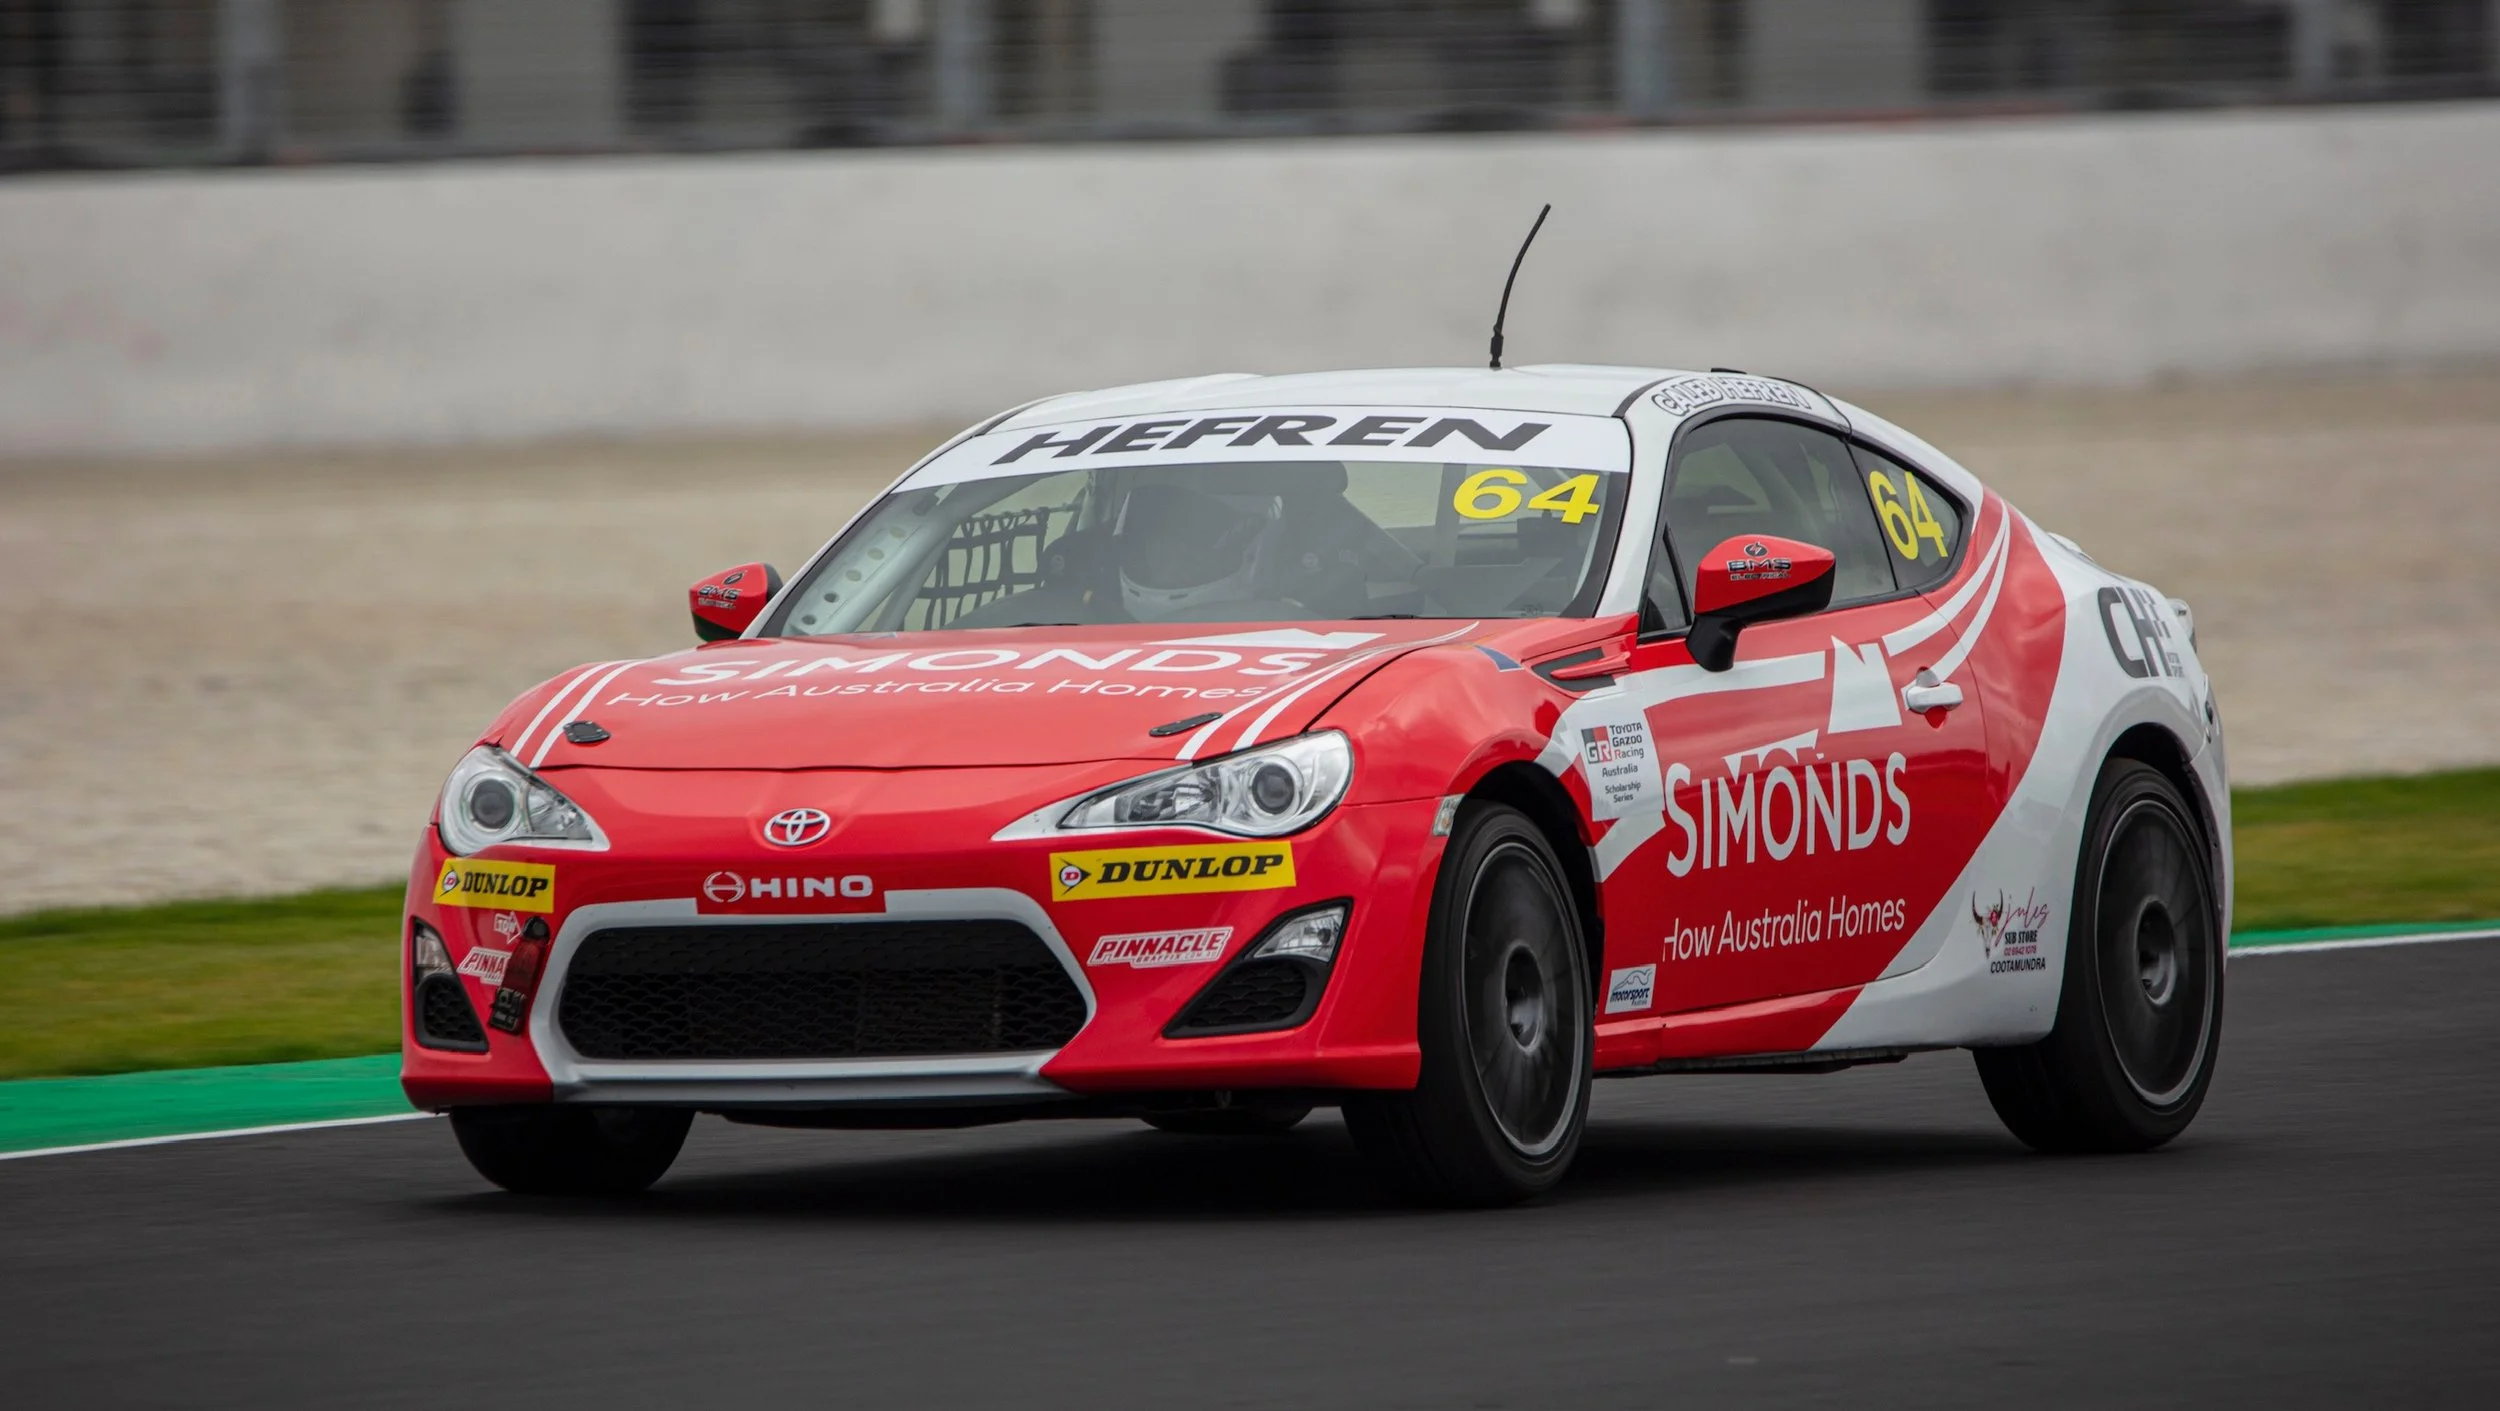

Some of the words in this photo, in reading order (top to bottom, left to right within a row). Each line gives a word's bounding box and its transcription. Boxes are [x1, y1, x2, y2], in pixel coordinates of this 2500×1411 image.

[1651, 377, 1724, 416] CALEB
[1715, 376, 1812, 410] HEFREN
[990, 415, 1552, 466] HEFREN
[1453, 469, 1600, 524] 64
[1869, 470, 1949, 560] 64
[1727, 558, 1792, 571] BMS
[652, 648, 1327, 686] SIMONDS
[605, 691, 752, 707] How
[752, 678, 1036, 699] Australia
[1047, 680, 1268, 699] Homes
[1609, 722, 1643, 735] TOYOTA
[1586, 740, 1611, 763] GR
[1612, 735, 1643, 747] GAZOO
[1614, 746, 1645, 759] Racing
[1602, 763, 1638, 777] Australia
[1605, 781, 1641, 794] Scholarship
[1613, 793, 1634, 803] Series
[1665, 752, 1911, 877] SIMONDS
[1097, 854, 1284, 884] DUNLOP
[462, 871, 548, 898] DUNLOP
[751, 875, 873, 899] HINO
[1663, 918, 1715, 962] How
[1717, 899, 1822, 954] Australia
[1827, 895, 1906, 940] Homes
[2018, 930, 2038, 944] STORE
[1096, 932, 1227, 959] PINNACLE
[464, 952, 506, 973] PINNA
[1991, 957, 2046, 974] COOTAMUNDRA
